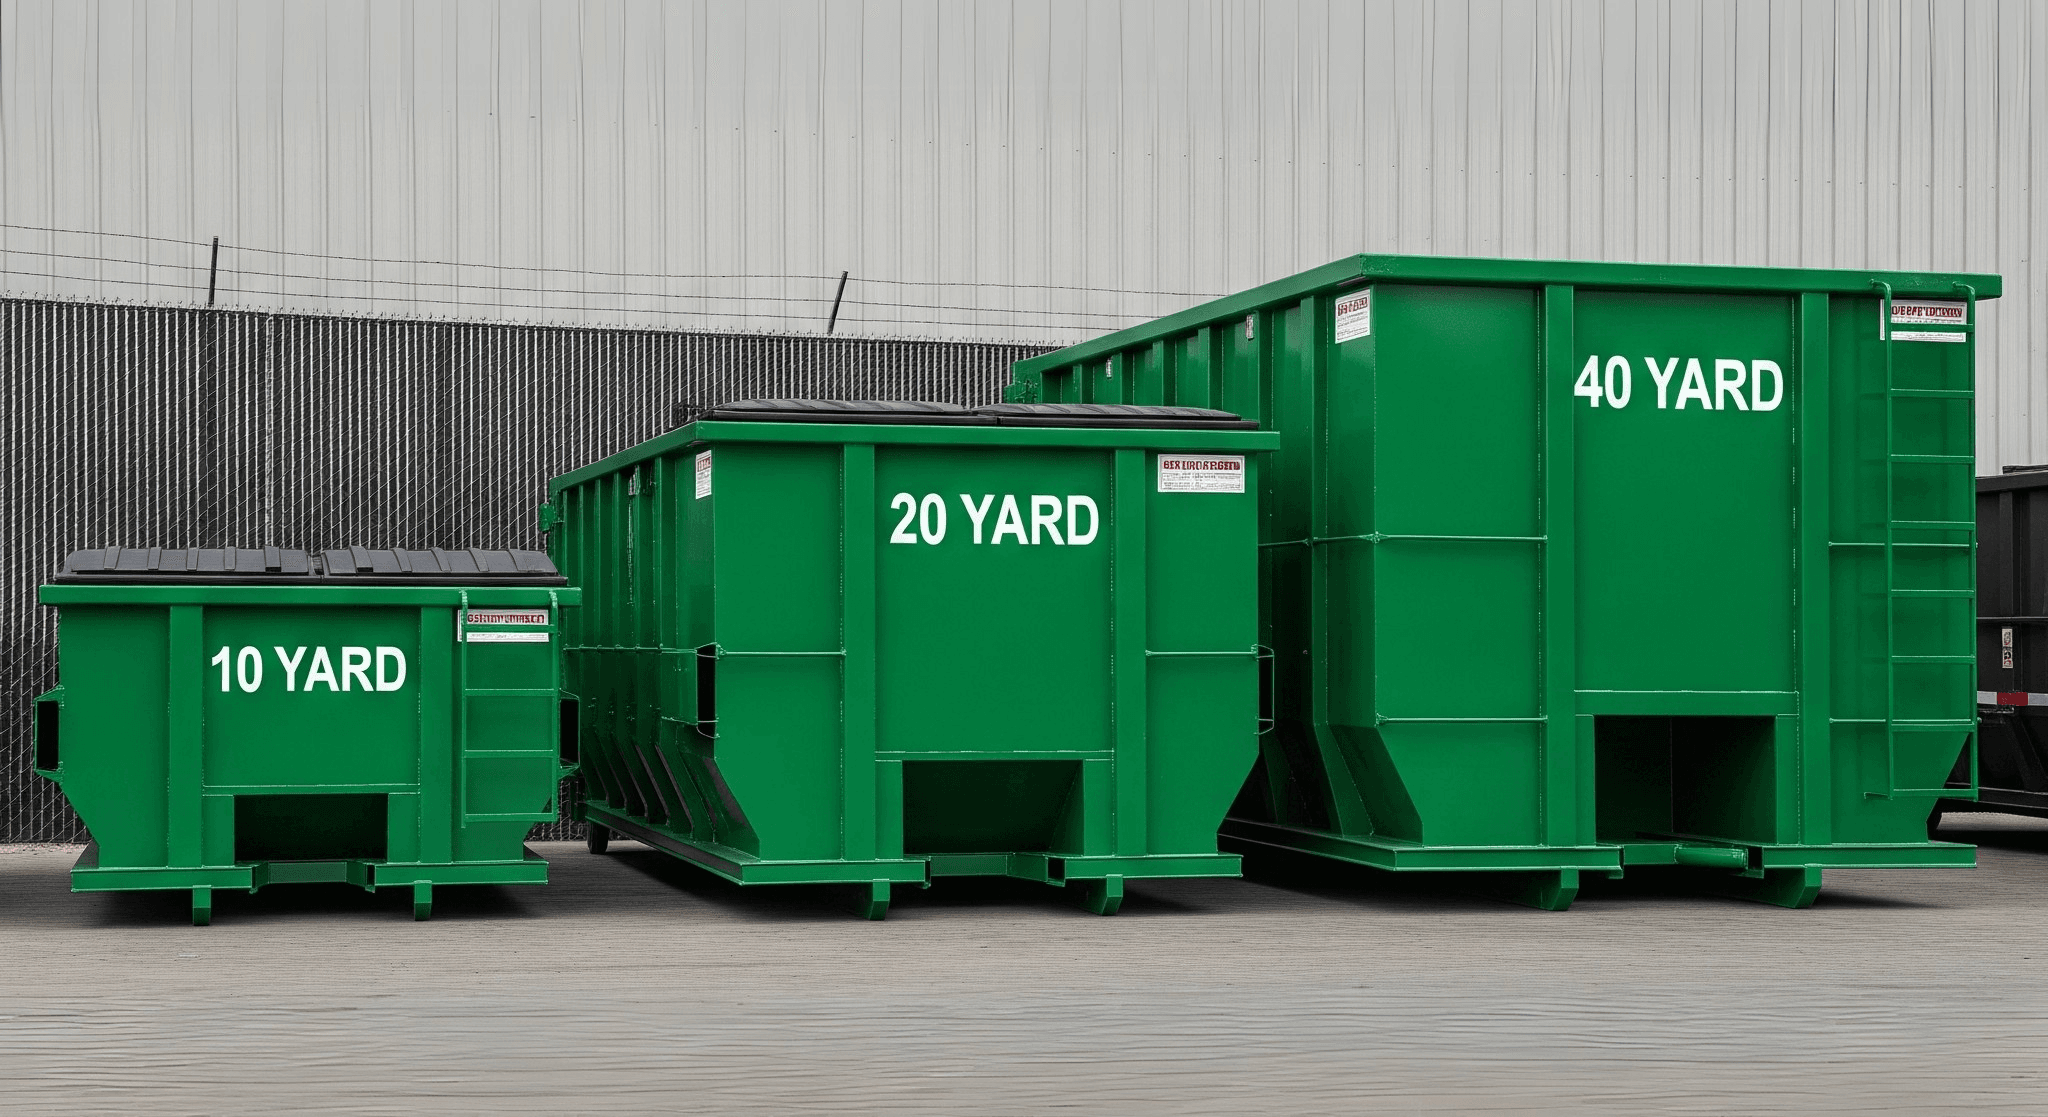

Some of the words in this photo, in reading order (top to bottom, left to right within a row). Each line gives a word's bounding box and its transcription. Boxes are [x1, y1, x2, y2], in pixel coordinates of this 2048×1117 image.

[1575, 356, 1631, 408] 40
[1645, 358, 1784, 411] YARD
[890, 493, 946, 544] 20
[960, 495, 1099, 545] YARD
[212, 646, 262, 692] 10
[274, 646, 407, 692] YARD
